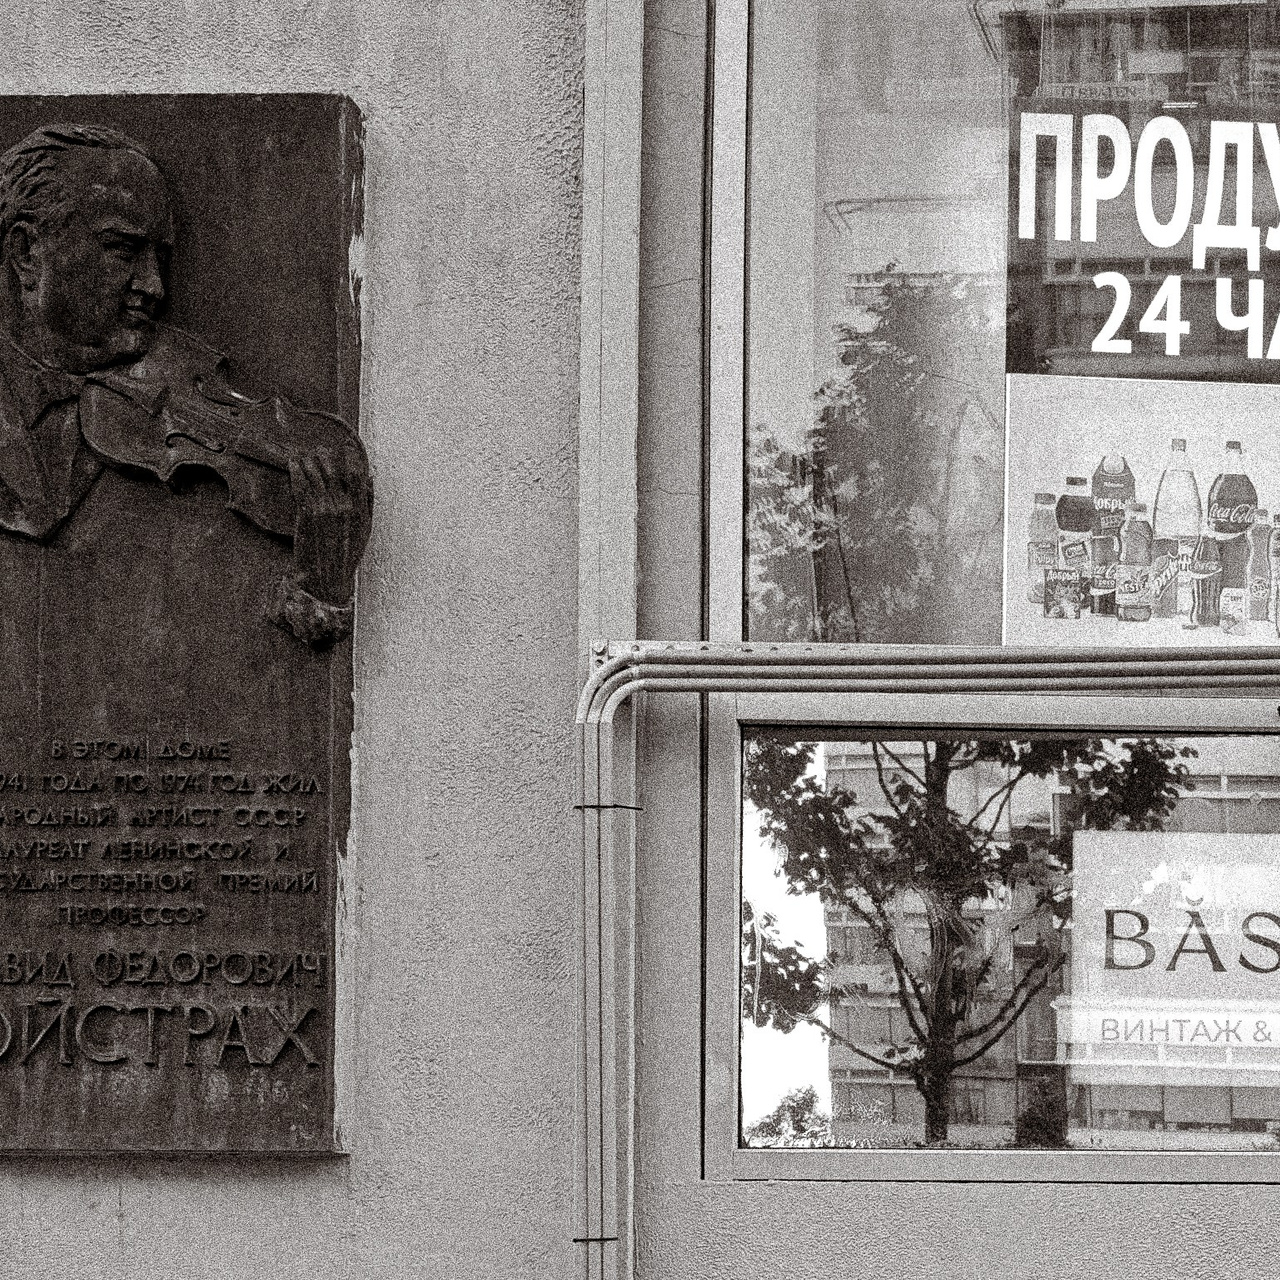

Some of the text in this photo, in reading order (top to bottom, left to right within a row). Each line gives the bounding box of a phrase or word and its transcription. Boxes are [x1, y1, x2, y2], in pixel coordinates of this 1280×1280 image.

[1090, 270, 1190, 356] 24
[51, 740, 231, 761] В ЭТОМ ДОМЕ
[43, 773, 101, 793] ГОДА
[114, 774, 149, 793] ПО
[210, 774, 255, 793] ГОД
[262, 774, 324, 793] ЖИЛ
[129, 806, 223, 827] АРТИСТ
[234, 806, 305, 827] СССР
[101, 837, 251, 860] ЛЕНИНСКОЙ
[274, 842, 290, 861] И
[219, 869, 320, 893] ПРЕМИЙ
[58, 904, 206, 925] ПРОФЕССОР
[93, 949, 326, 987] ФЕДОРОВИЧ
[0, 995, 319, 1067] ЙСТРАХ
[1101, 1018, 1242, 1044] ВИНТАЖ
[1251, 1020, 1273, 1042] &
